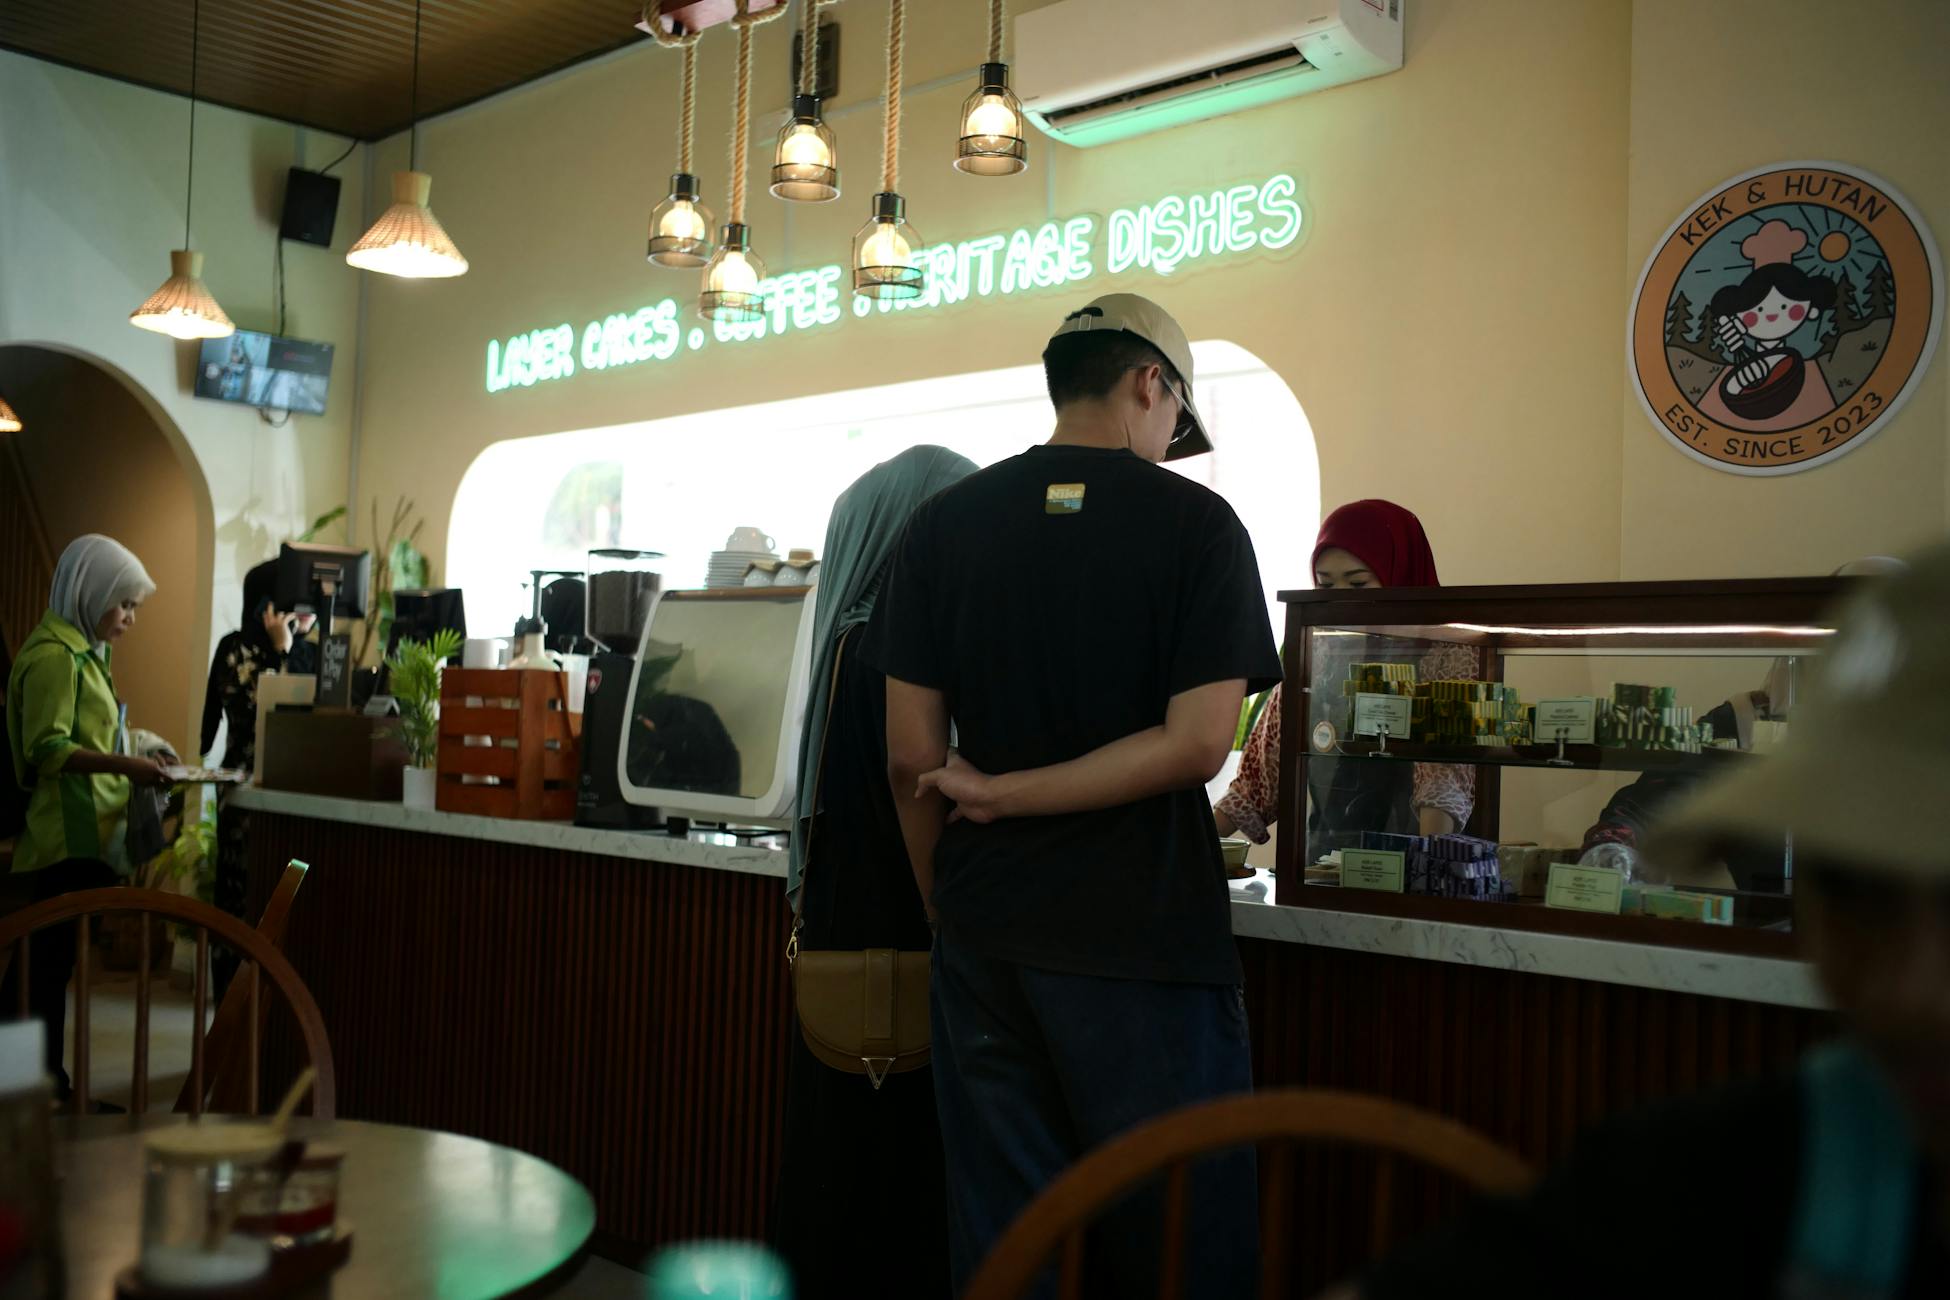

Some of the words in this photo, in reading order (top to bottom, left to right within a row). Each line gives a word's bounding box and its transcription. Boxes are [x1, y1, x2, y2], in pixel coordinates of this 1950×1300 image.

[1679, 196, 1734, 246] KEK
[1746, 181, 1767, 204] &
[1784, 174, 1888, 223] HUTAN
[581, 298, 680, 370] CAKES
[1107, 174, 1302, 275] DISHES
[1665, 403, 1710, 447] EST.
[1723, 435, 1806, 459] SINCE
[1816, 391, 1884, 446] 2023
